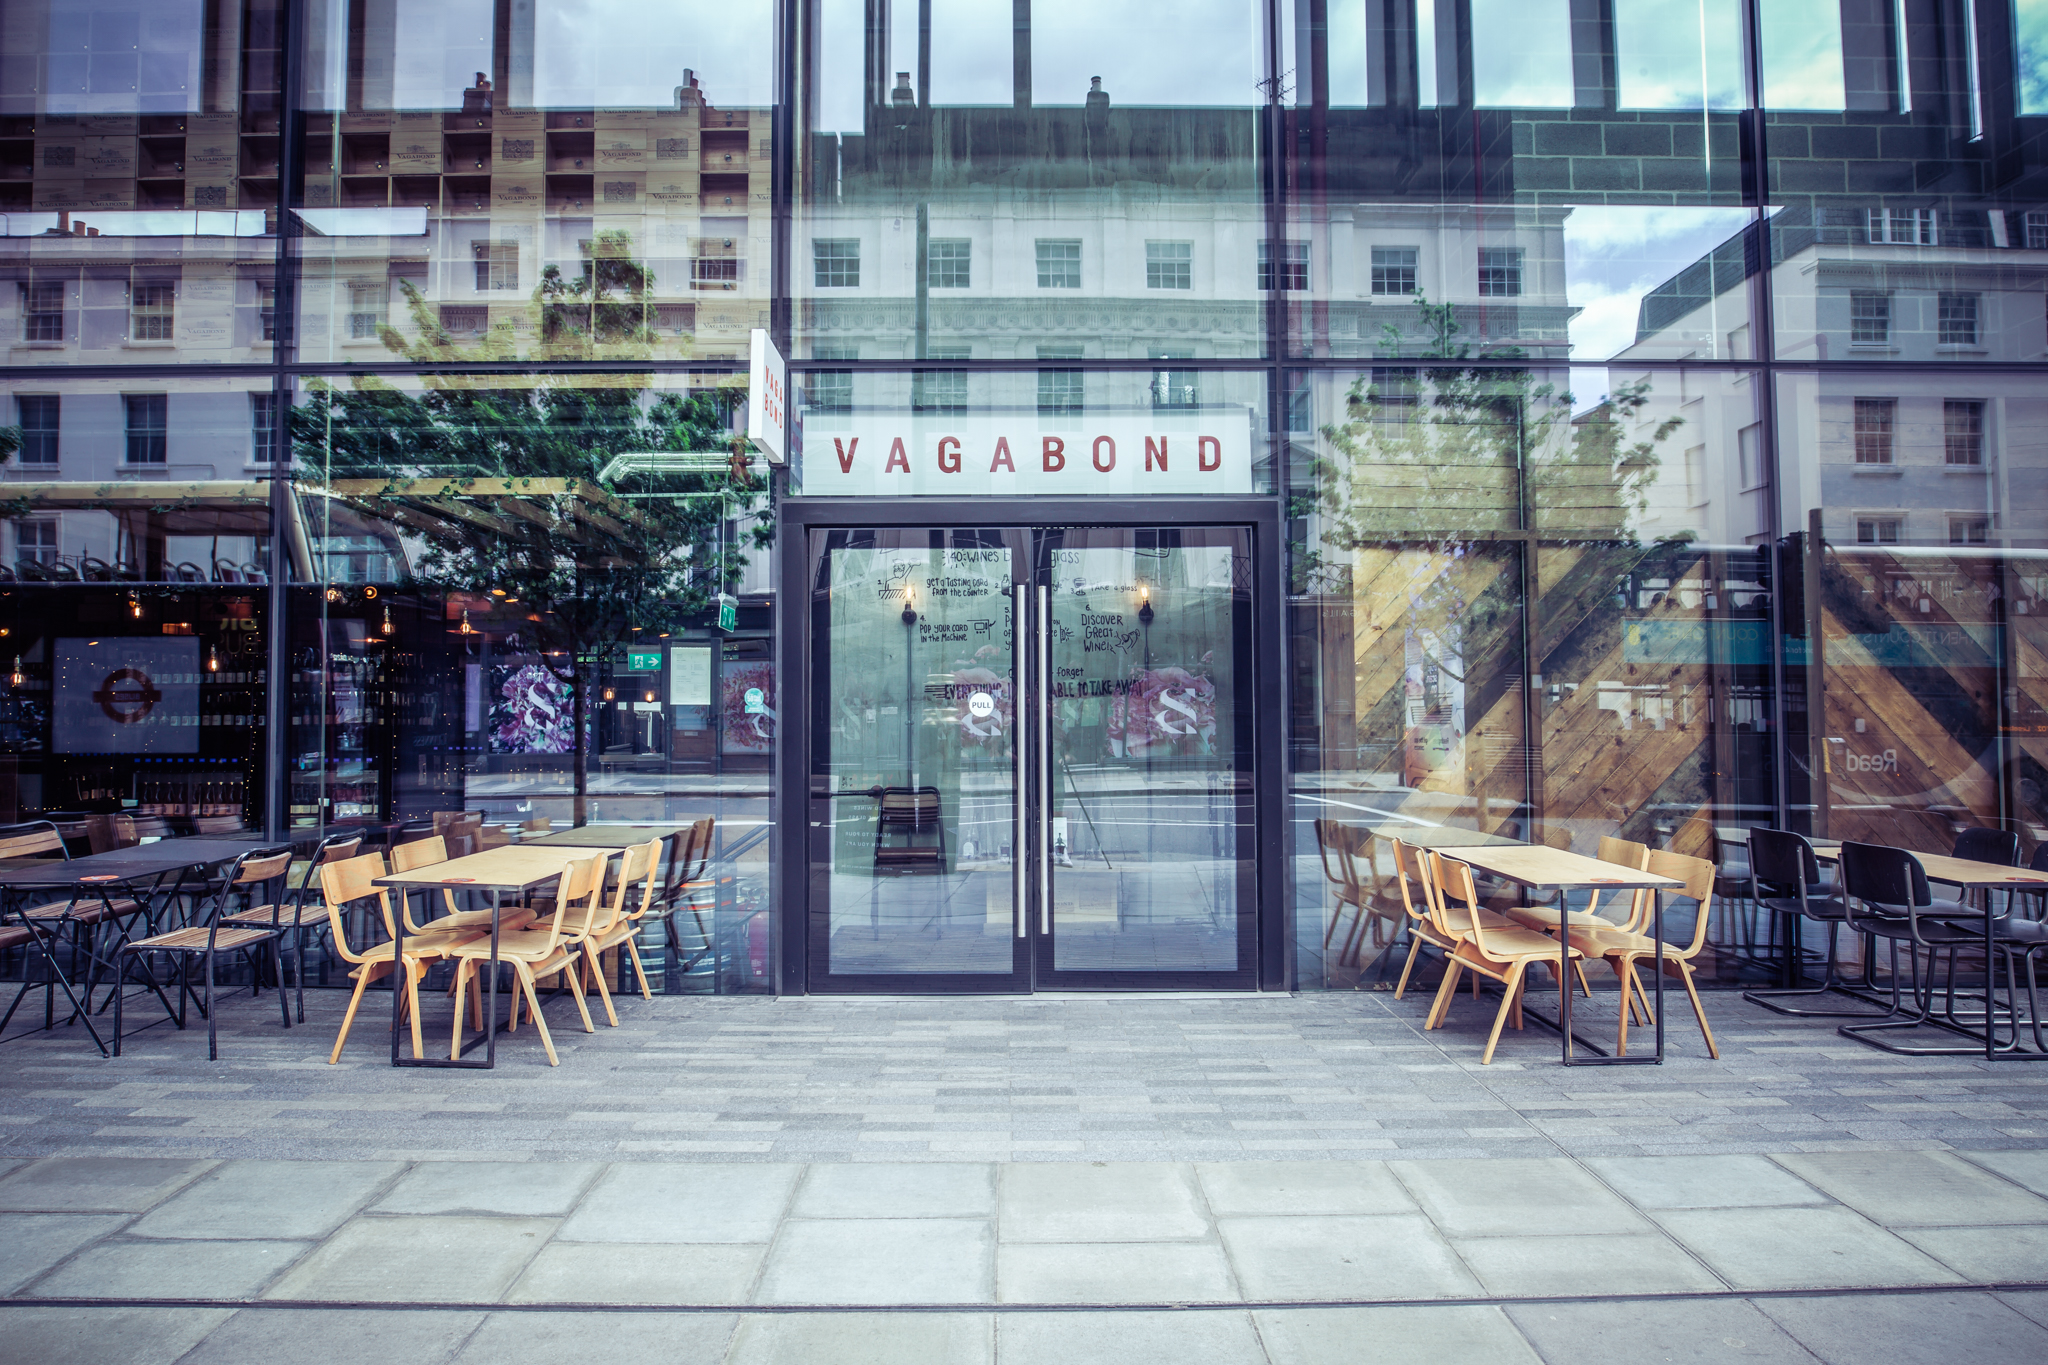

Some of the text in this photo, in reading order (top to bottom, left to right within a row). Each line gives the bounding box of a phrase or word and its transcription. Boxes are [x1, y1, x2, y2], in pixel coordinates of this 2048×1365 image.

[765, 366, 783, 405] VAGA
[764, 392, 783, 429] BOND
[833, 435, 1222, 474] VAGABOND
[920, 624, 932, 633] POP
[1089, 680, 1112, 696] TAKE
[972, 701, 991, 709] PULL
